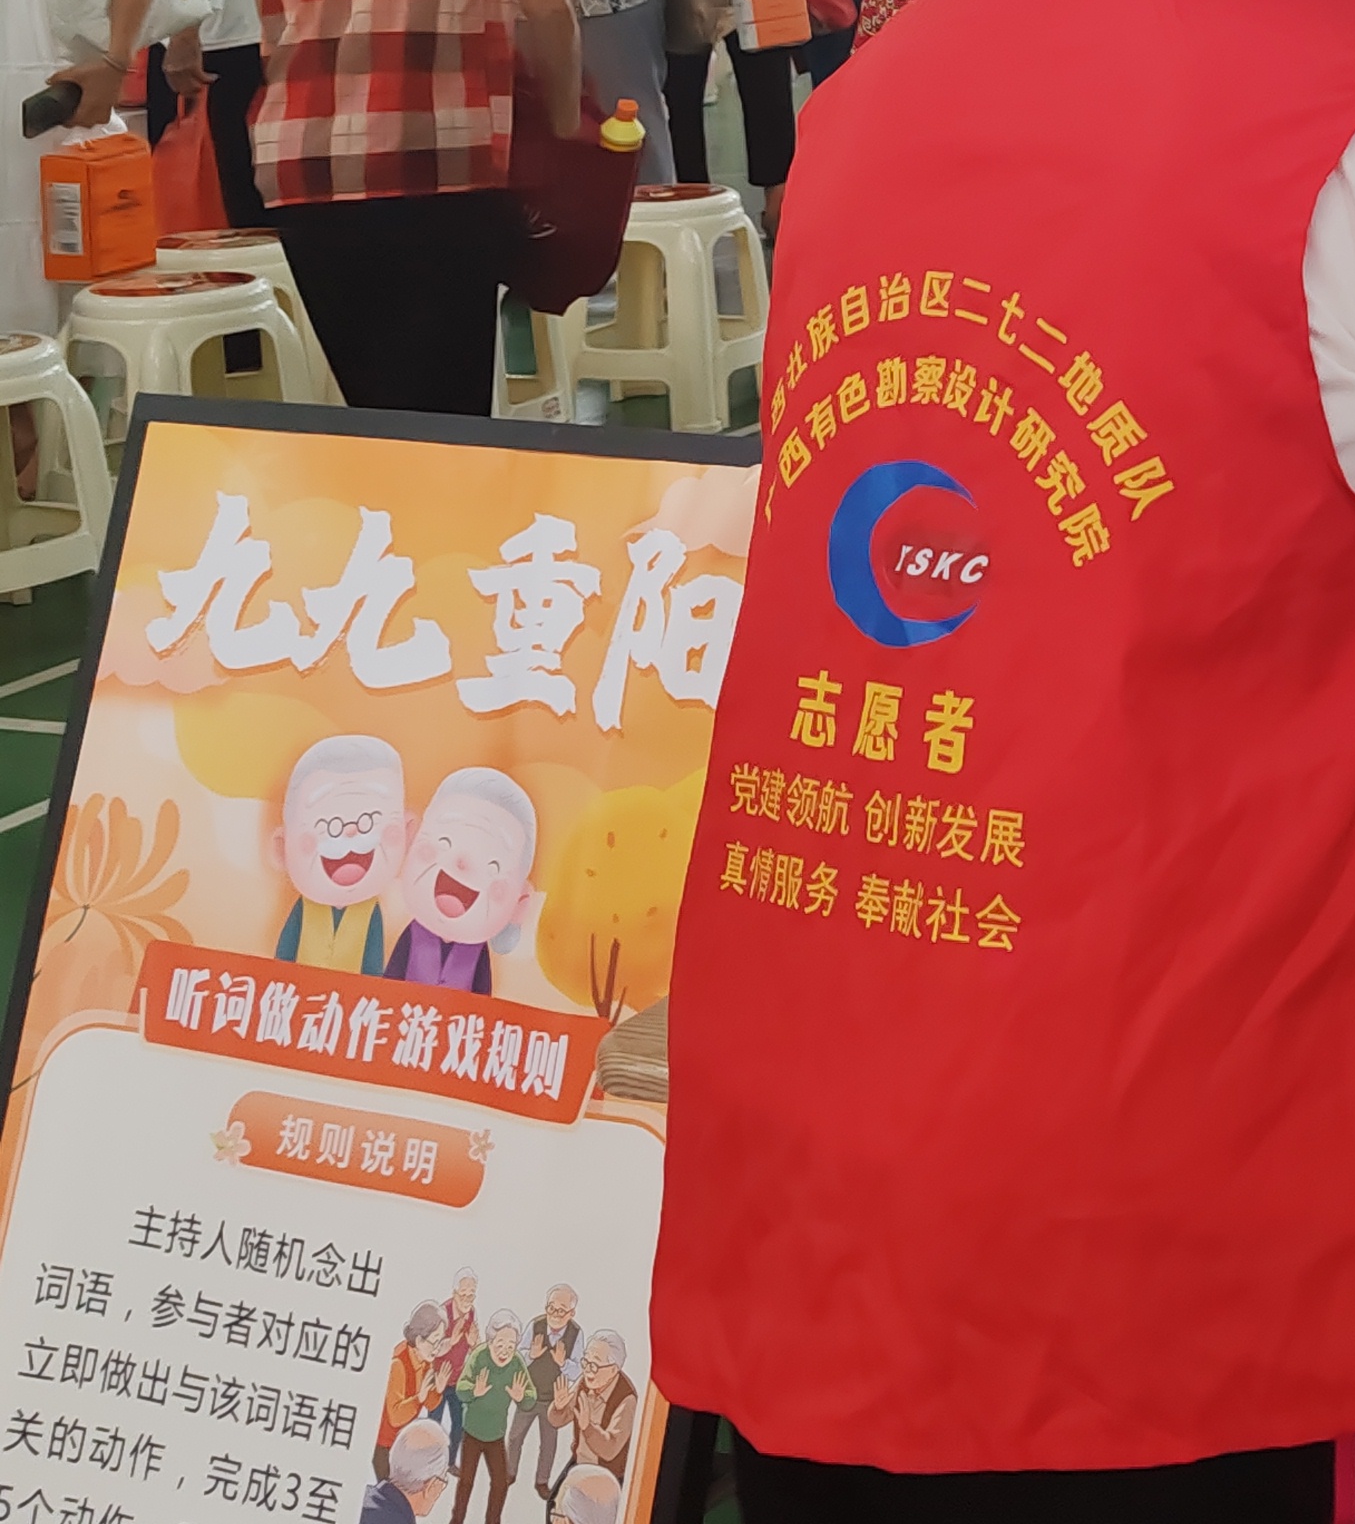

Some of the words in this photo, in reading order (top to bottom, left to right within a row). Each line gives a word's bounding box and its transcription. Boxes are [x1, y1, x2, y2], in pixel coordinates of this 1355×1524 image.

[145, 491, 746, 734] 九九重阳
[894, 543, 989, 585] YSKC
[789, 669, 974, 775] 志愿者
[729, 762, 851, 837] 党建领航
[864, 788, 1026, 868] 创新发展
[720, 841, 841, 919] 真情服务
[855, 873, 1022, 953] 奉献社会
[165, 966, 571, 1101] 听词做动作游戏规则
[275, 1114, 440, 1186] 规则说明
[127, 1205, 384, 1298] 主持人随机念出
[33, 1262, 372, 1374] 词语，参与者对应的
[17, 1337, 358, 1451] 立即做出与该词语相
[4, 1408, 344, 1524] 关的动作，完成3至
